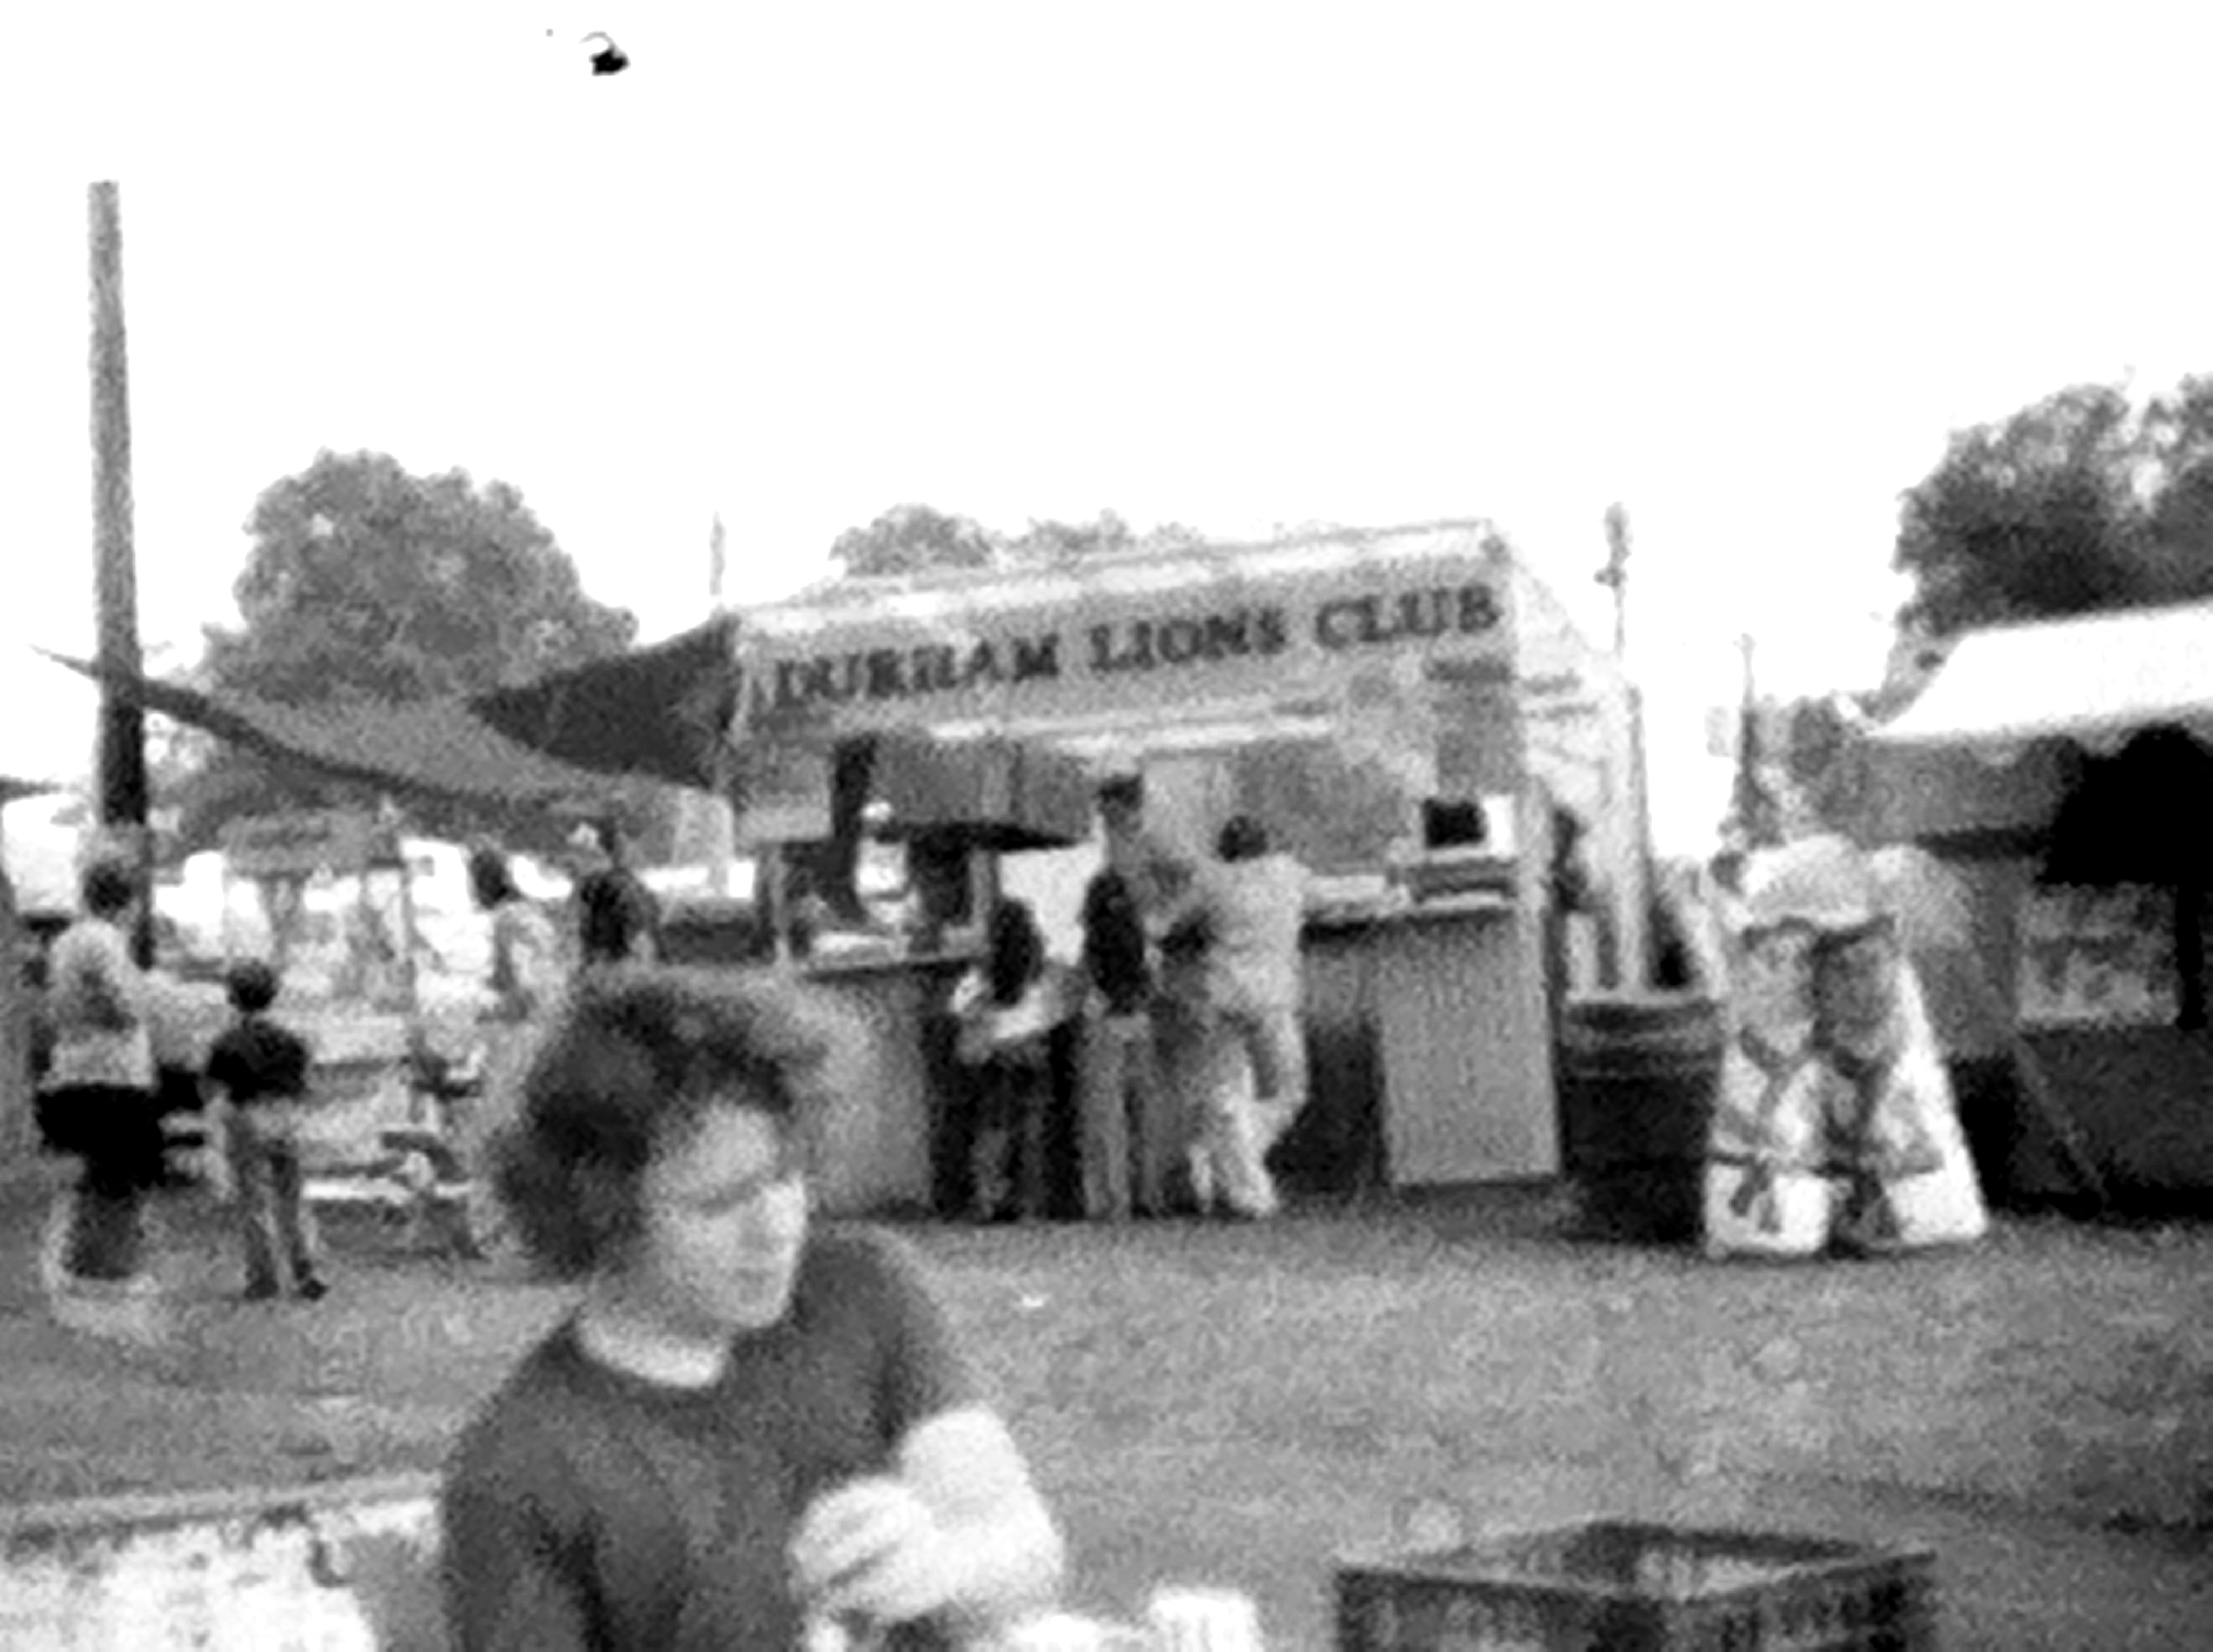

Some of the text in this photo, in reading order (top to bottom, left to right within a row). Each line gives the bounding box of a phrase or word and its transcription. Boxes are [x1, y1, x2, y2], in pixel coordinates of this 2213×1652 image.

[775, 585, 1499, 704] DURHAM LIONS CLUB
